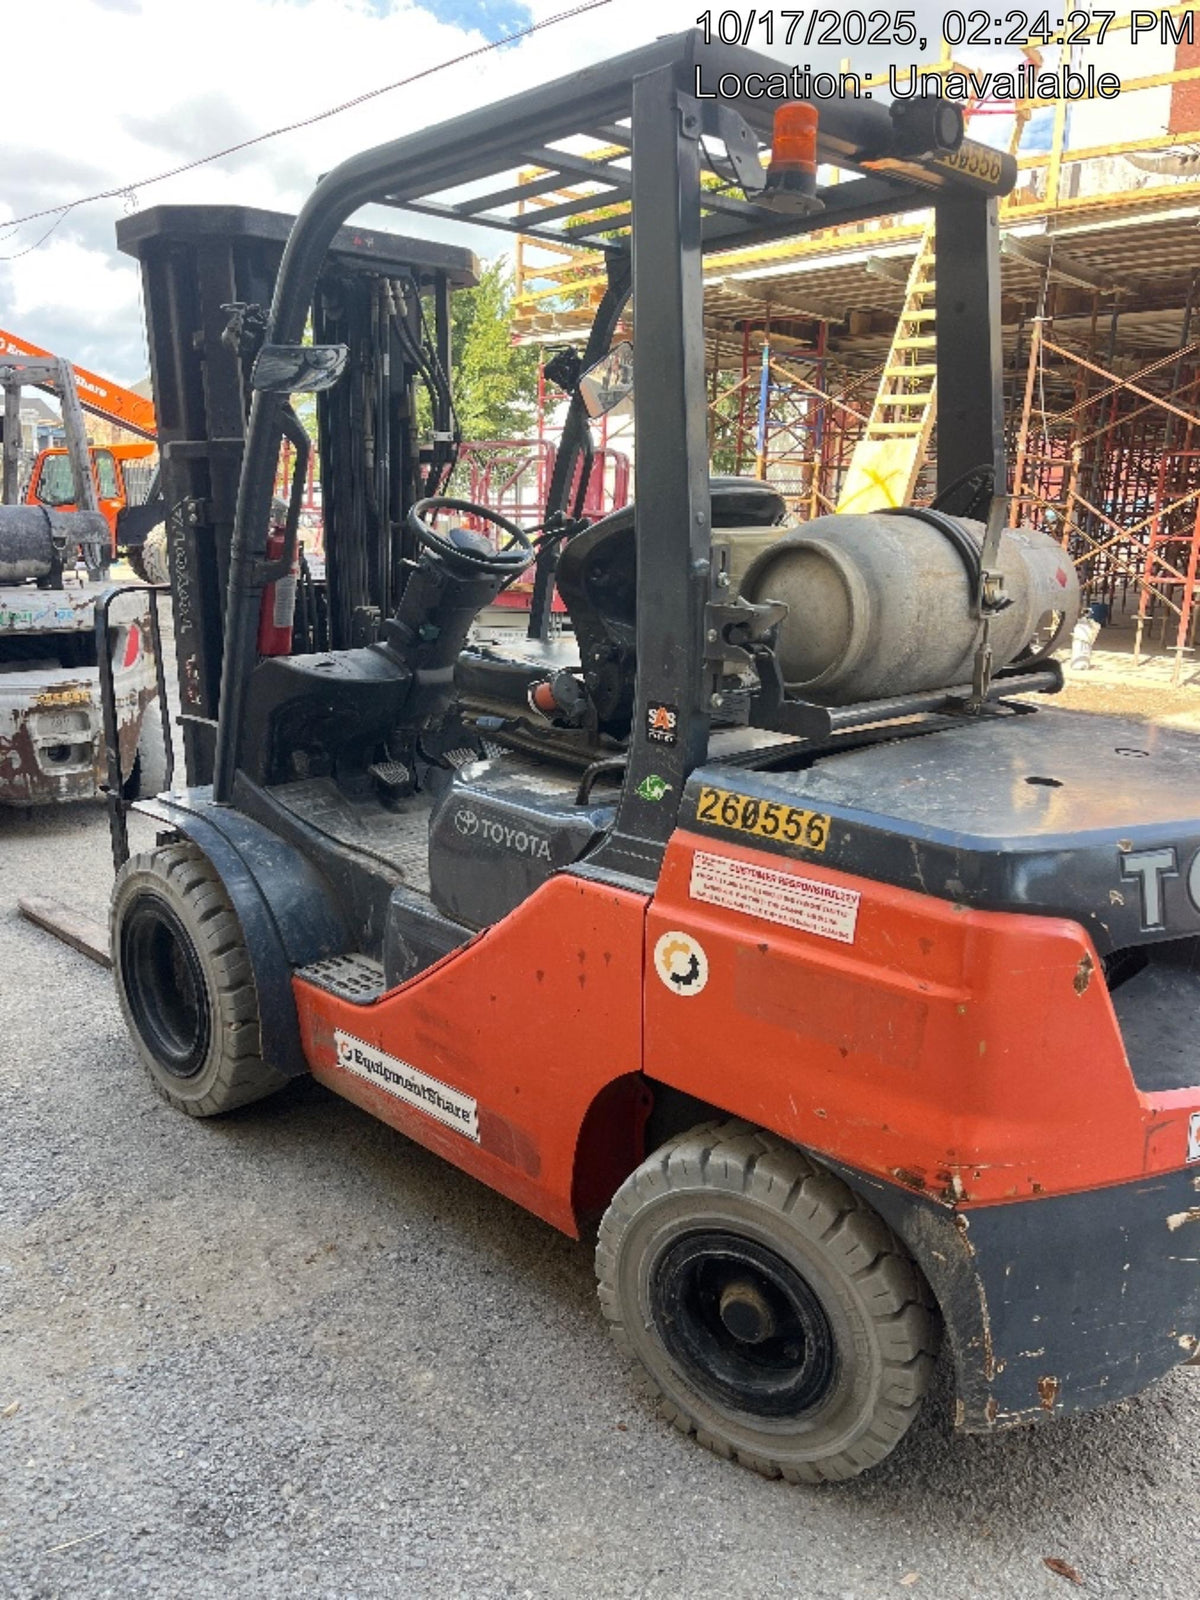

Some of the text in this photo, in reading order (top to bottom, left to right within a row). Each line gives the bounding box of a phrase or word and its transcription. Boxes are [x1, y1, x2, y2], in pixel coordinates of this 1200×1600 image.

[481, 819, 552, 861] TOYOTA
[700, 788, 827, 847] 260556
[353, 1048, 471, 1124] EquipmentShare
